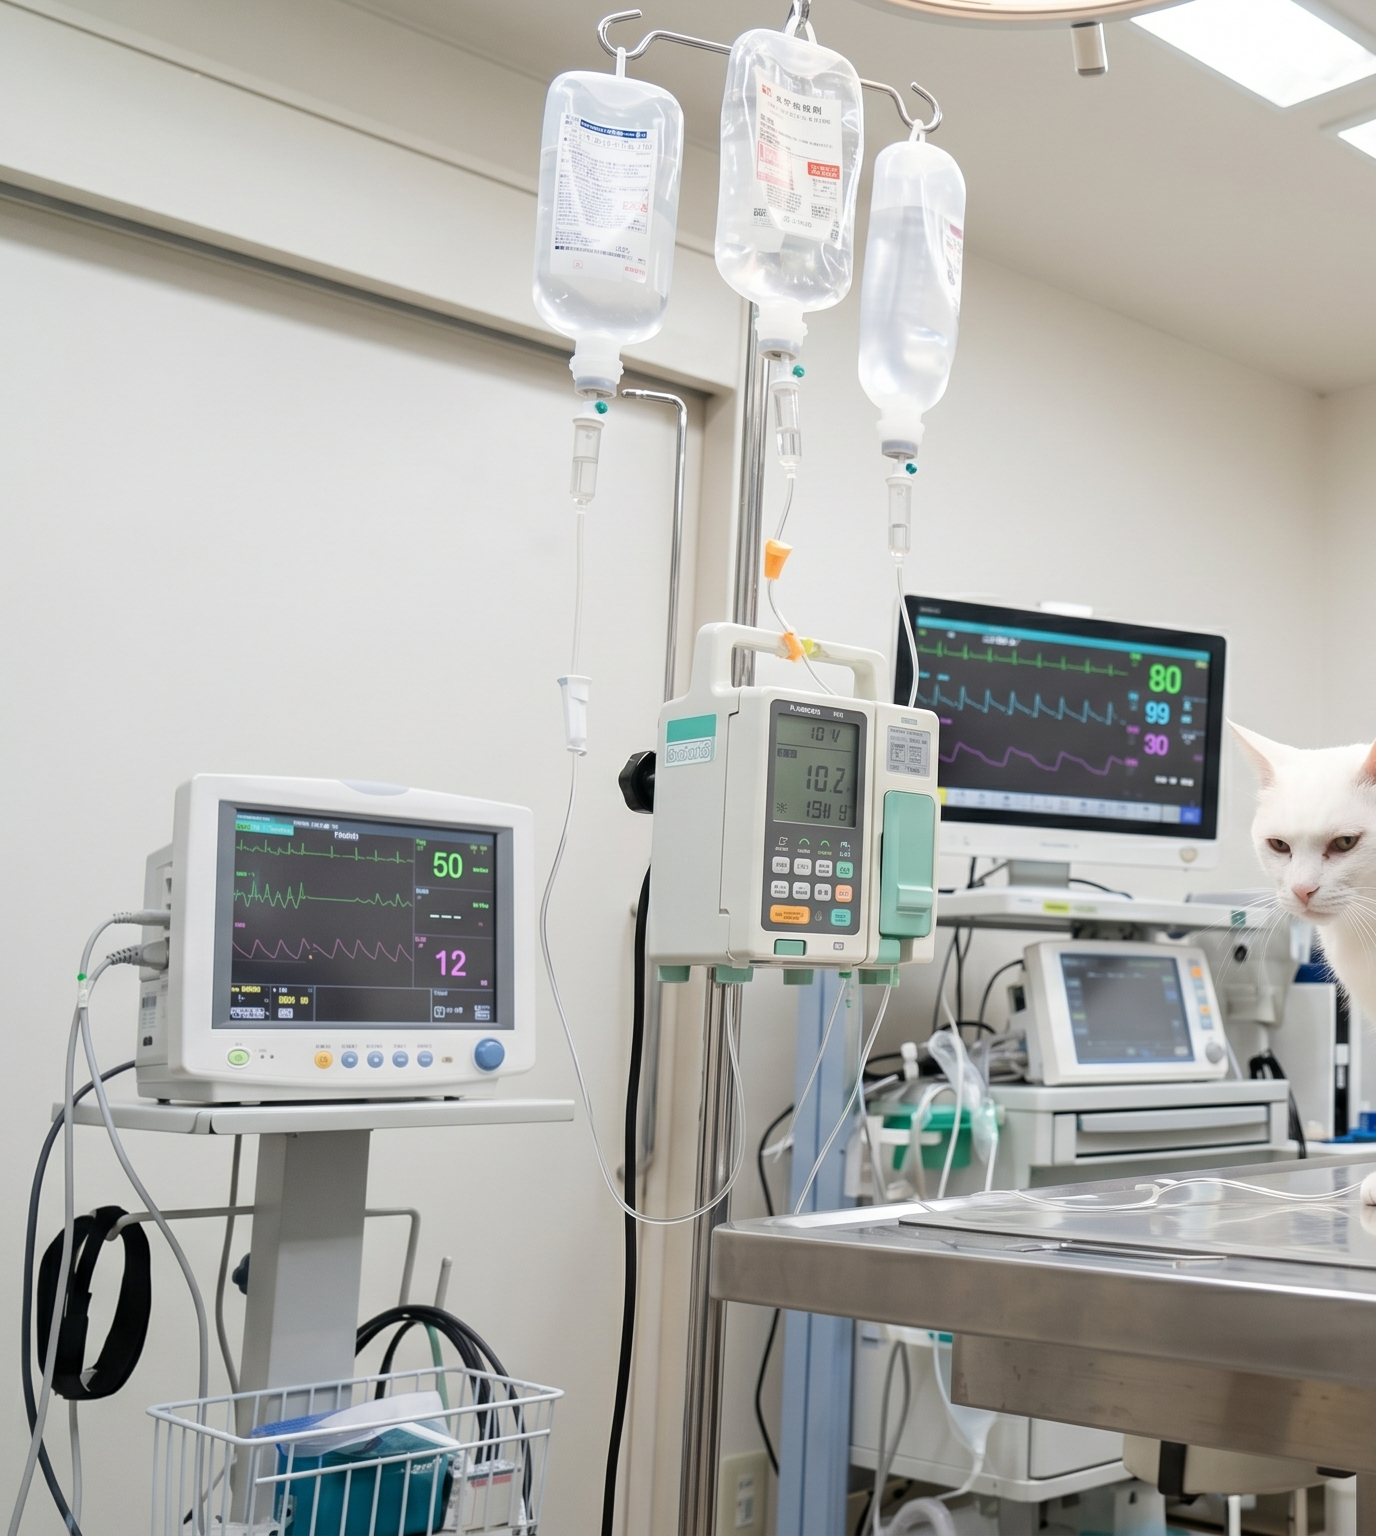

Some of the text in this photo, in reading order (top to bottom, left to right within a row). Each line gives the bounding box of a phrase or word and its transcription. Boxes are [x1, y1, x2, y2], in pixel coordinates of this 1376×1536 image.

[1149, 663, 1182, 694] 80
[1145, 701, 1171, 725] 99
[1143, 733, 1169, 756] 30
[433, 851, 463, 879] 50
[435, 949, 467, 977] 12
